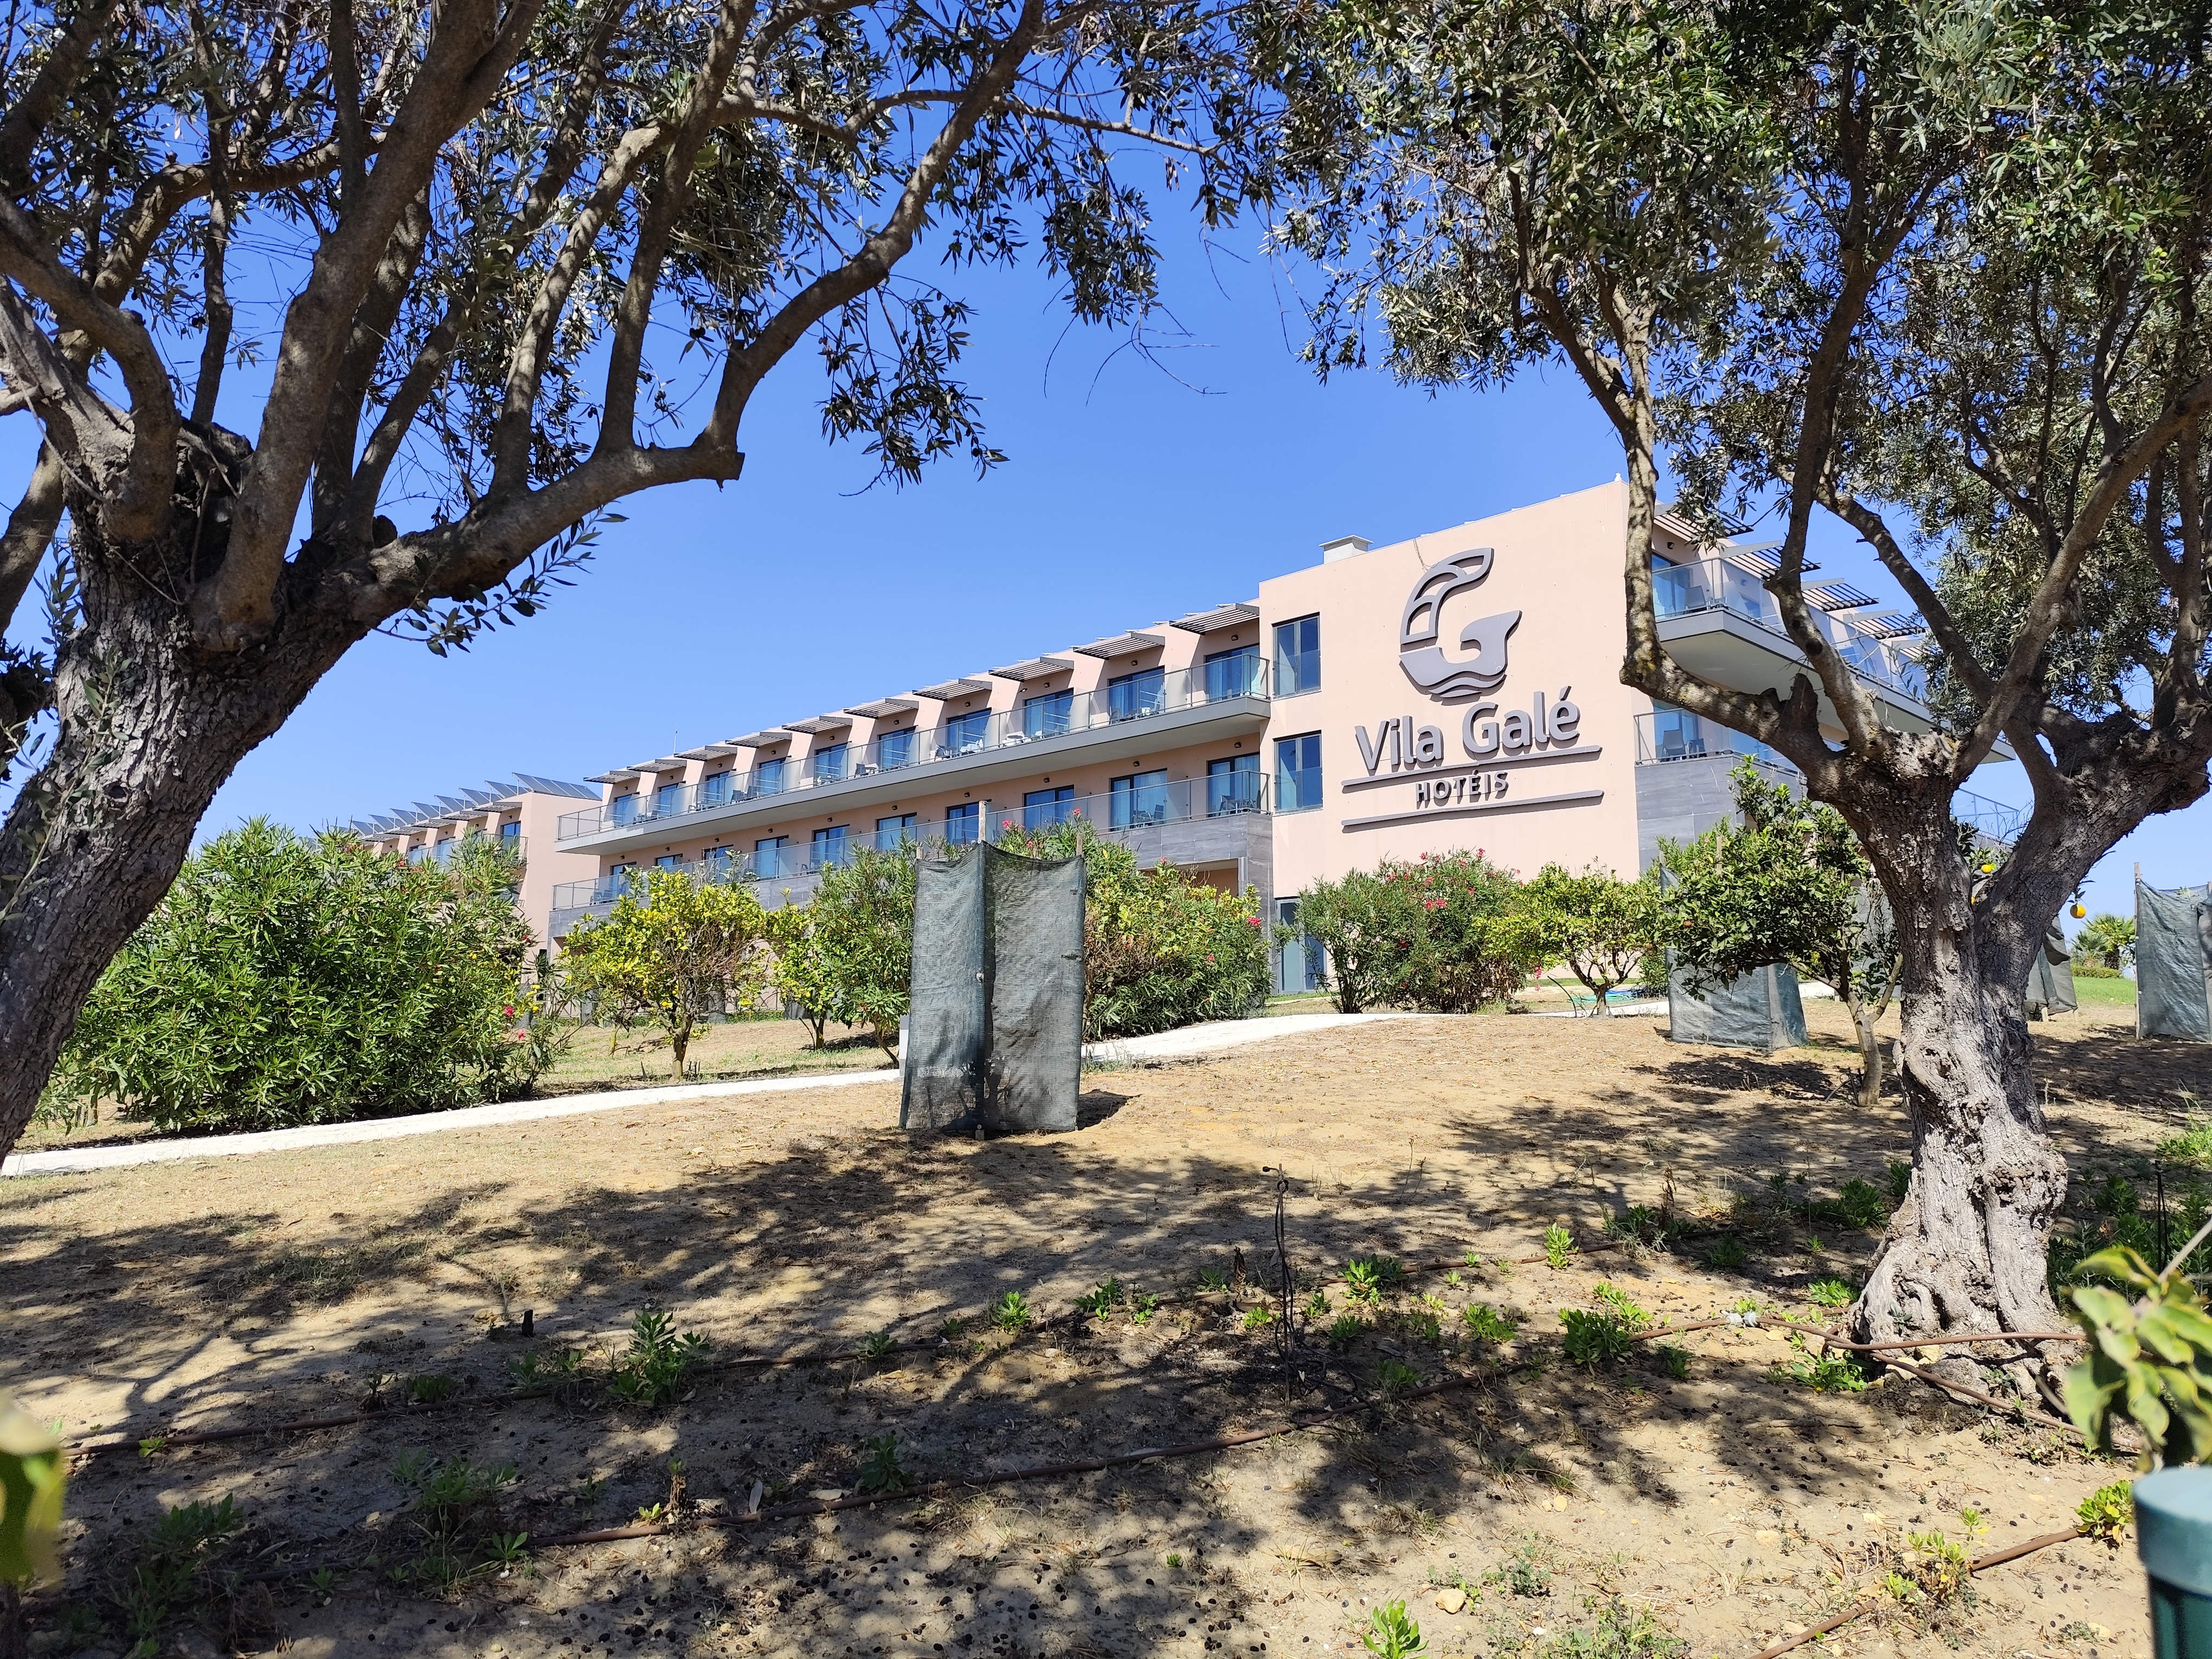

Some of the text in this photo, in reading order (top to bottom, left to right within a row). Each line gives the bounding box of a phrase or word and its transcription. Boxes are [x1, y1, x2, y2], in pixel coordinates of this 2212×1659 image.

[1355, 686, 1580, 772] Vila Galé
[1416, 770, 1509, 803] HOTÉIS
